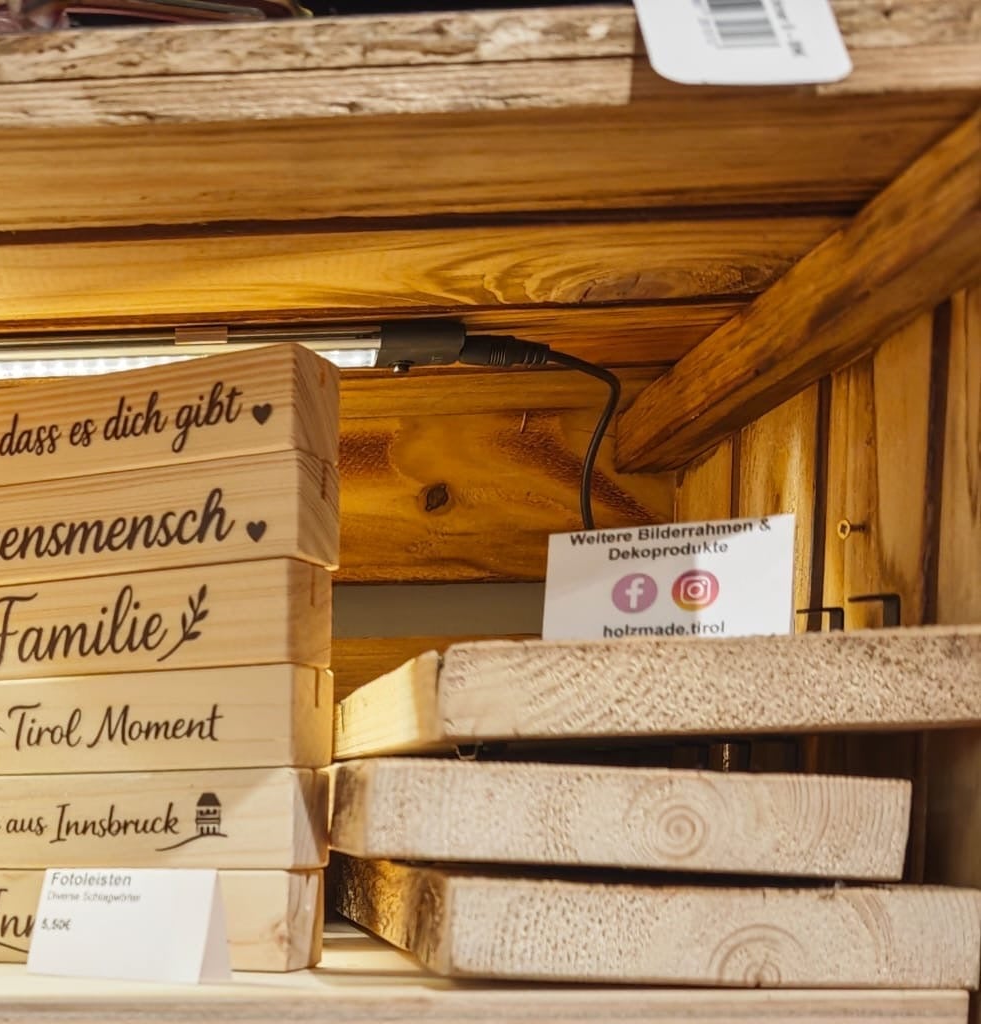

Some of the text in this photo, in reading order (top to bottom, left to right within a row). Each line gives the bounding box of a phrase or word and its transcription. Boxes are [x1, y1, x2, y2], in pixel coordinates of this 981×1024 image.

[69, 419, 97, 447] es
[103, 391, 169, 440] dich
[171, 381, 245, 453] gibt
[570, 519, 772, 546] Weitere Bilderrahmen &
[608, 541, 729, 561] Dekoprodukte
[603, 620, 726, 638] holzmade.tirol
[7, 702, 225, 751] Tirol Moment
[5, 816, 48, 835] aus
[48, 801, 181, 844] Innsbruck
[51, 871, 132, 887] Fotoleisten
